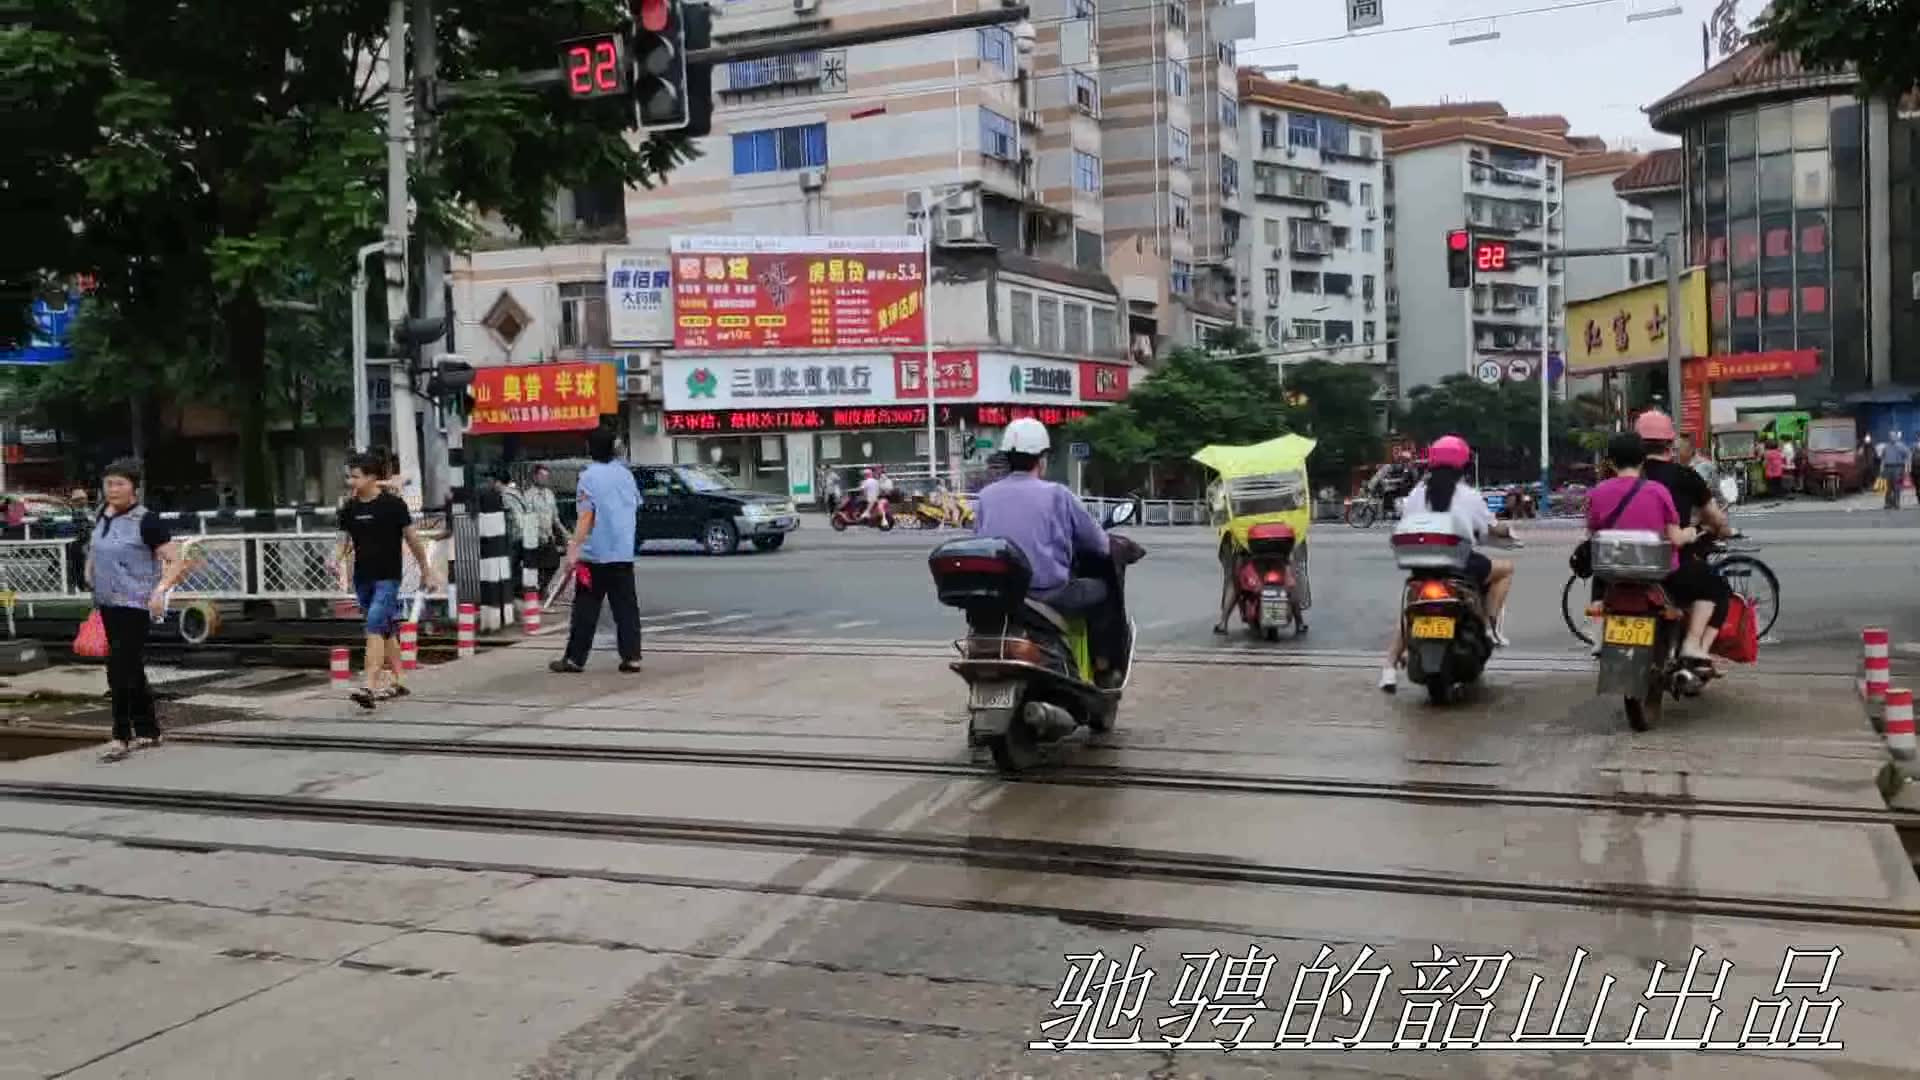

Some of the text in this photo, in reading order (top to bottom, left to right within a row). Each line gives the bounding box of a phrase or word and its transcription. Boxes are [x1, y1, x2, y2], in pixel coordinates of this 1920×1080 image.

[569, 43, 617, 92] 22
[823, 57, 844, 87] 米
[1479, 247, 1505, 269] 22
[555, 367, 597, 400] 半球
